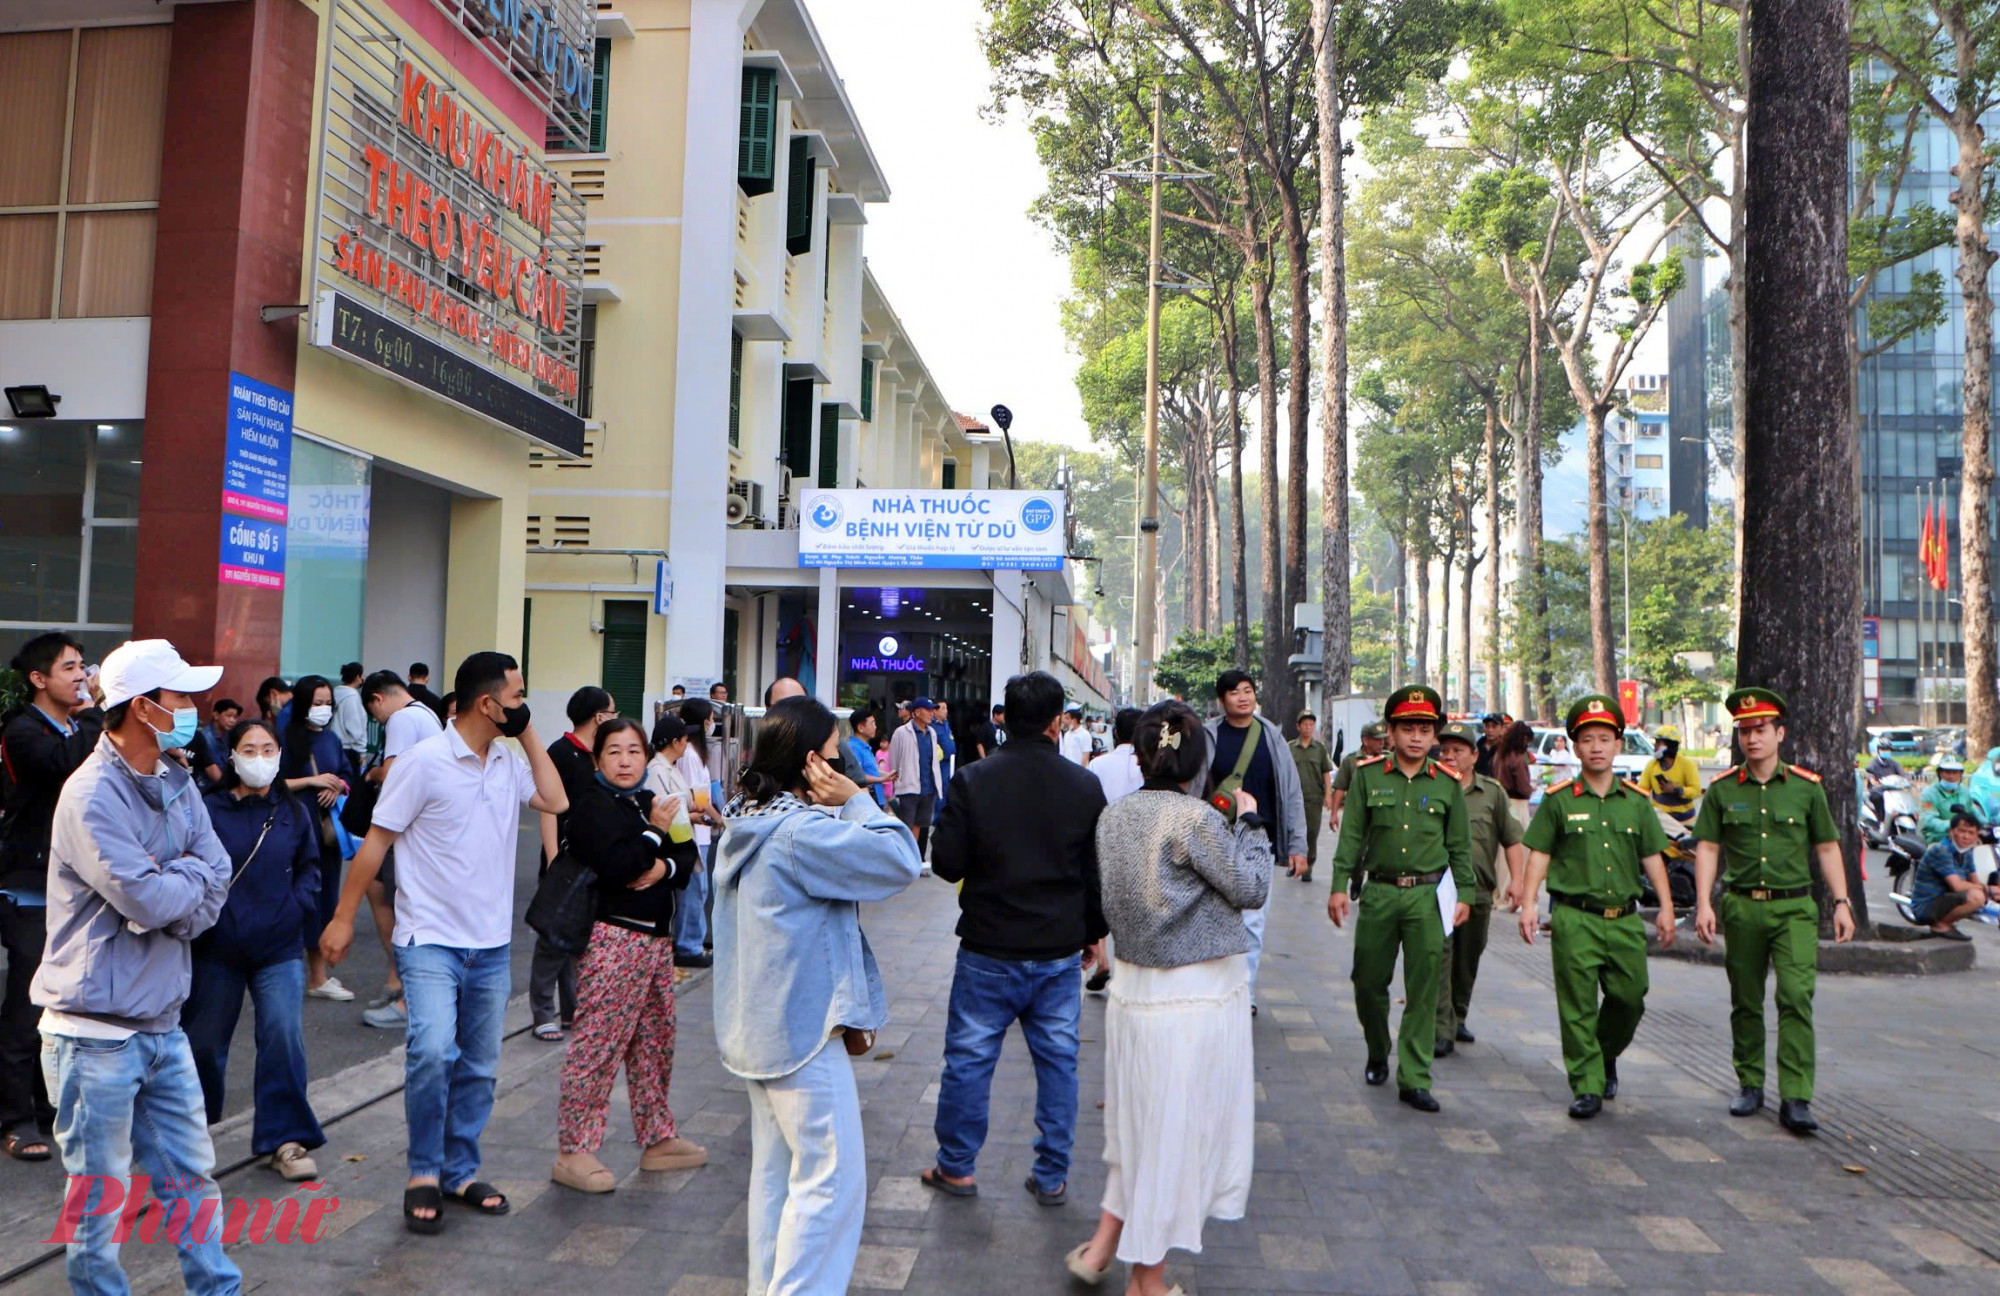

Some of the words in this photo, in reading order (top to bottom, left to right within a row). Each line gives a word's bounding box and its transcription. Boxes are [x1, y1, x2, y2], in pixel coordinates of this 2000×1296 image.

[402, 61, 470, 169] KHU
[364, 143, 453, 262] THEO
[459, 213, 512, 299] YÊU
[336, 226, 382, 289] SẢN
[386, 261, 426, 323] PHỤ
[430, 287, 480, 347] KHOA
[233, 385, 251, 402] KHÁM
[252, 392, 267, 407] THEO
[267, 396, 278, 411] YÊU
[279, 400, 290, 416] CẦU
[237, 406, 251, 421] SẢN
[252, 412, 266, 428] PHỤ
[267, 418, 284, 433] KHOA
[241, 427, 258, 442] HIẾM
[259, 433, 279, 449] MUỘN
[872, 495, 916, 515] NHÀ
[920, 492, 990, 515] THUỐC
[846, 518, 899, 540] BỆNH
[904, 519, 950, 541] VIỆN
[955, 519, 984, 538] TỪ
[988, 520, 1016, 539] DŨ
[1025, 514, 1050, 524] GPP
[230, 520, 256, 548] CỔNG
[258, 528, 271, 551] SỐ
[272, 535, 279, 553] 5
[243, 551, 258, 565] KHU
[258, 554, 265, 566] N
[851, 656, 878, 671] NHÀ
[881, 654, 925, 671] THUỐC
